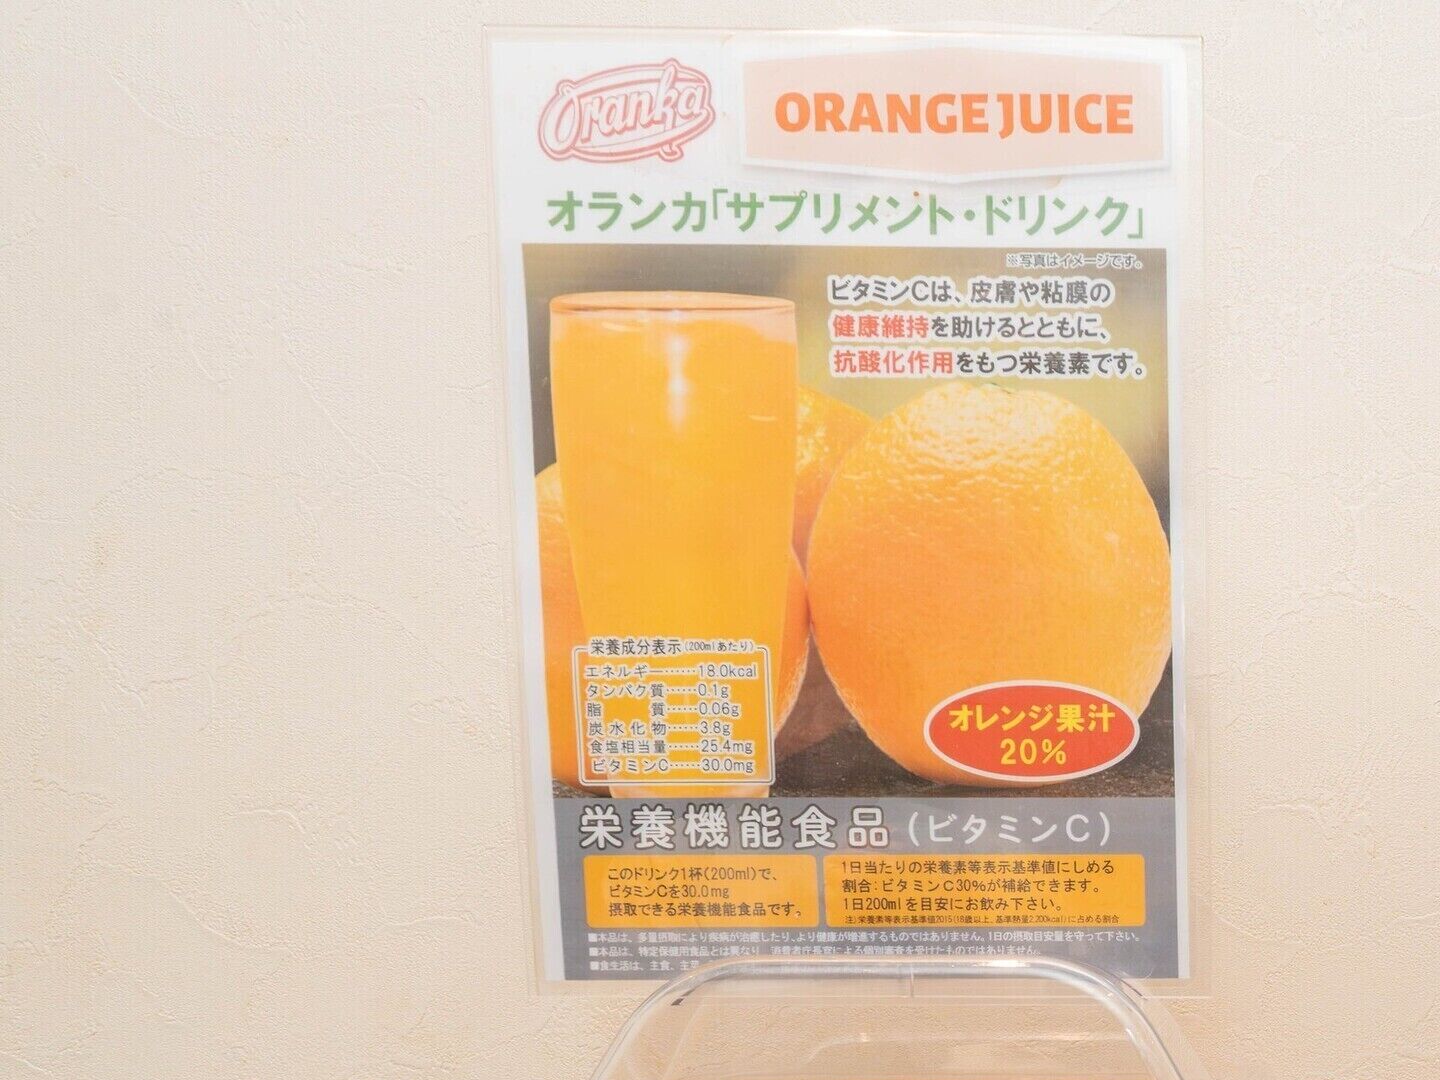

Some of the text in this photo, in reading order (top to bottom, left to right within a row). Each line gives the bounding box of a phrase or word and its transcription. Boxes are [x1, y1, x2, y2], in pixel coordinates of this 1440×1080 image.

[544, 62, 713, 161] Oranka
[774, 91, 1134, 139] ORANGE JUICE
[547, 188, 1144, 240] オランカ「サプリメント・ドリンク」
[830, 279, 1112, 304] ビタミンCは、皮膚や粘膜の
[833, 351, 1145, 376] 抗酸化作用をもつ栄養素です。
[949, 703, 1117, 734] オレンジ果汁
[1000, 738, 1067, 767] 20%
